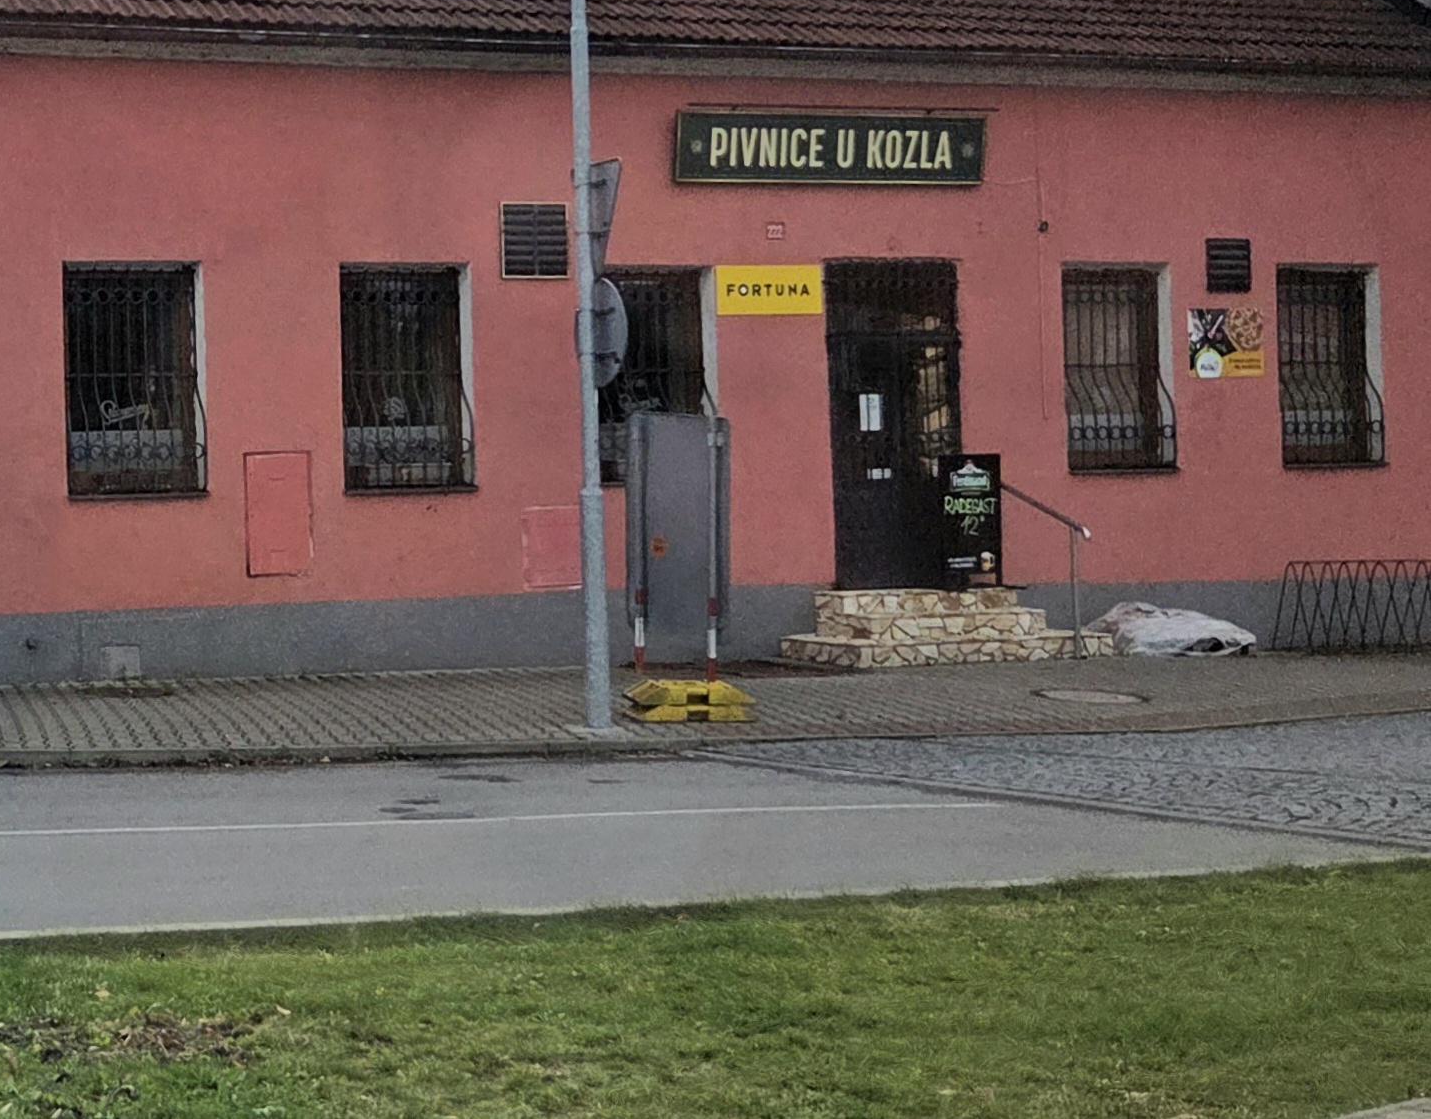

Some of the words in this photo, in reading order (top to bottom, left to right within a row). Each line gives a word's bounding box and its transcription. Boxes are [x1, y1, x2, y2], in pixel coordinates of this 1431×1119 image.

[709, 127, 825, 168] PIVNICE
[837, 128, 855, 169] U
[866, 129, 952, 170] KOZLA
[726, 283, 811, 298] FORTUNA
